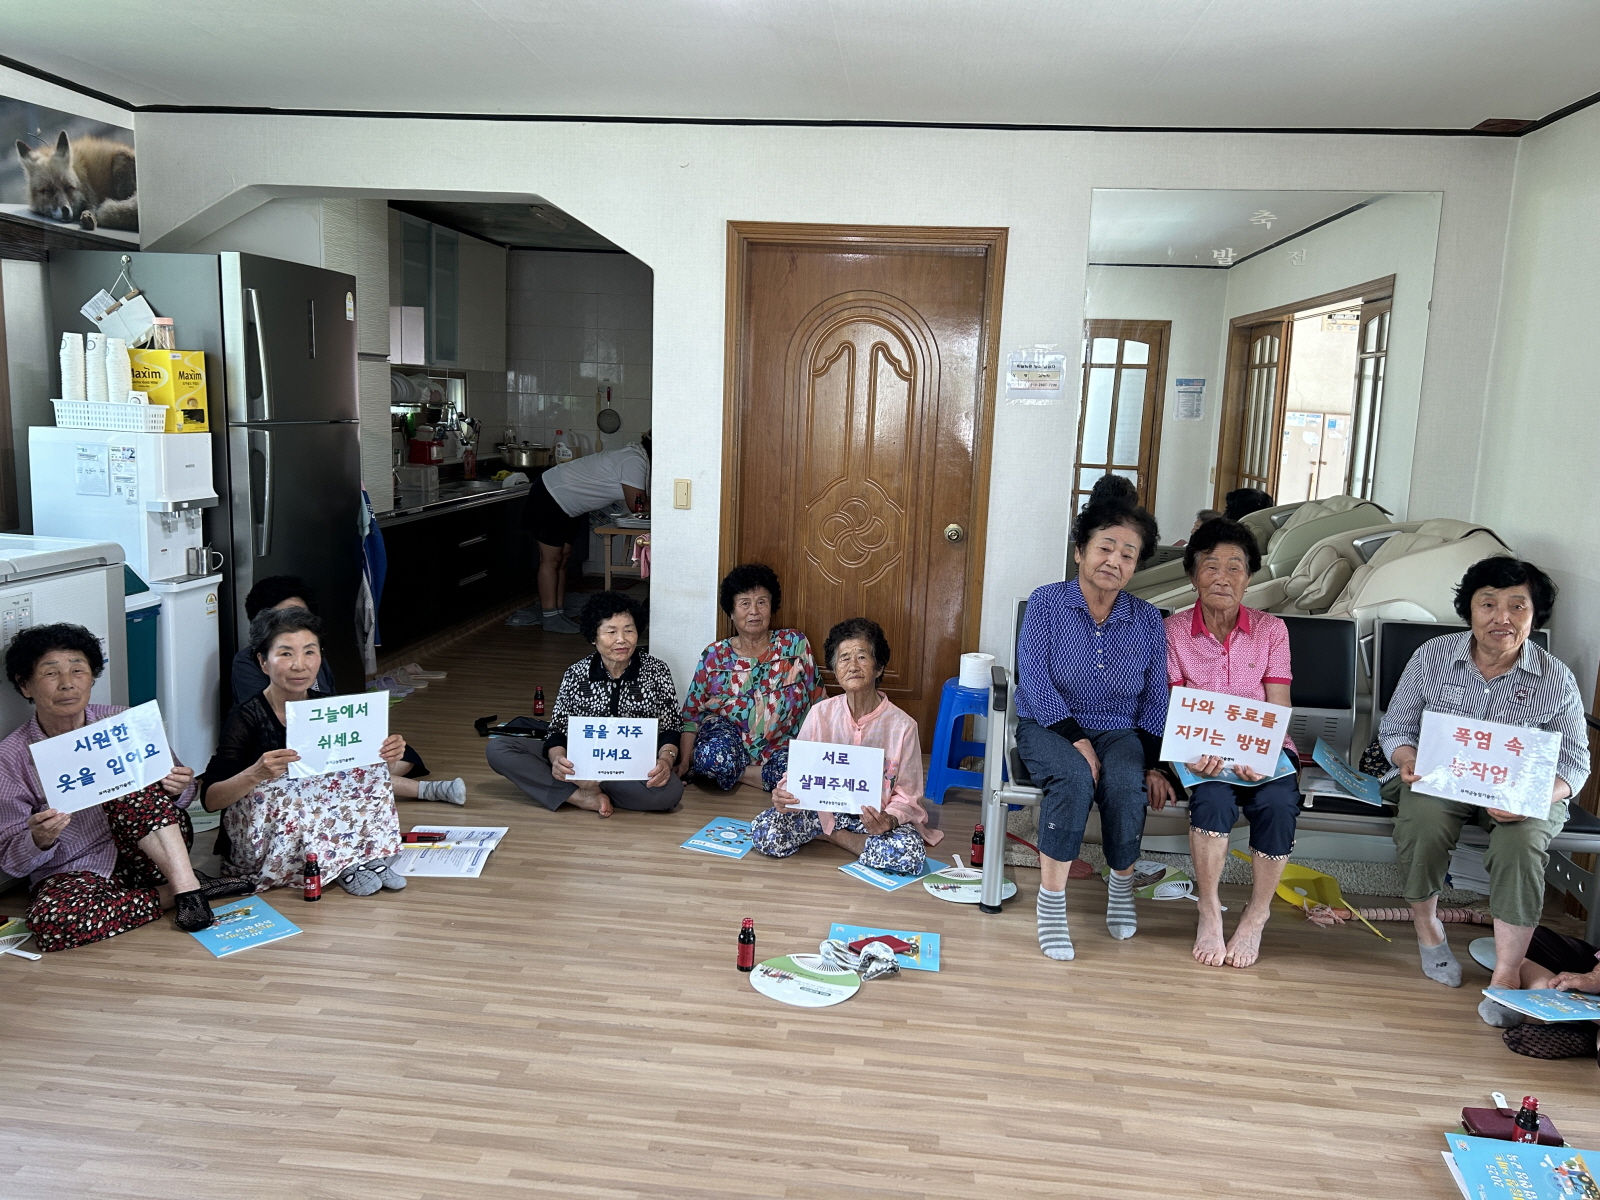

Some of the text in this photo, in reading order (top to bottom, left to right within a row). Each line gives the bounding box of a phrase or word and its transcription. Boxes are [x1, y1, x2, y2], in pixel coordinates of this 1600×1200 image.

[1249, 209, 1278, 230] 축
[1212, 247, 1307, 266] 발 전
[178, 369, 203, 381] Maxim
[309, 702, 368, 724] 그늘에서
[1181, 697, 1278, 729] 나와 동료를
[73, 723, 129, 753] 시원한
[317, 731, 362, 750] 쉬세요
[582, 724, 643, 739] 물을 자주
[1175, 725, 1271, 755] 지키는 방법
[1452, 727, 1524, 757] 폭염 속
[592, 748, 632, 761] 마셔요
[822, 751, 850, 765] 서로
[56, 743, 160, 794] 옷을 입어요
[799, 774, 870, 793] 살펴주세요
[1486, 1163, 1505, 1188] 2025
